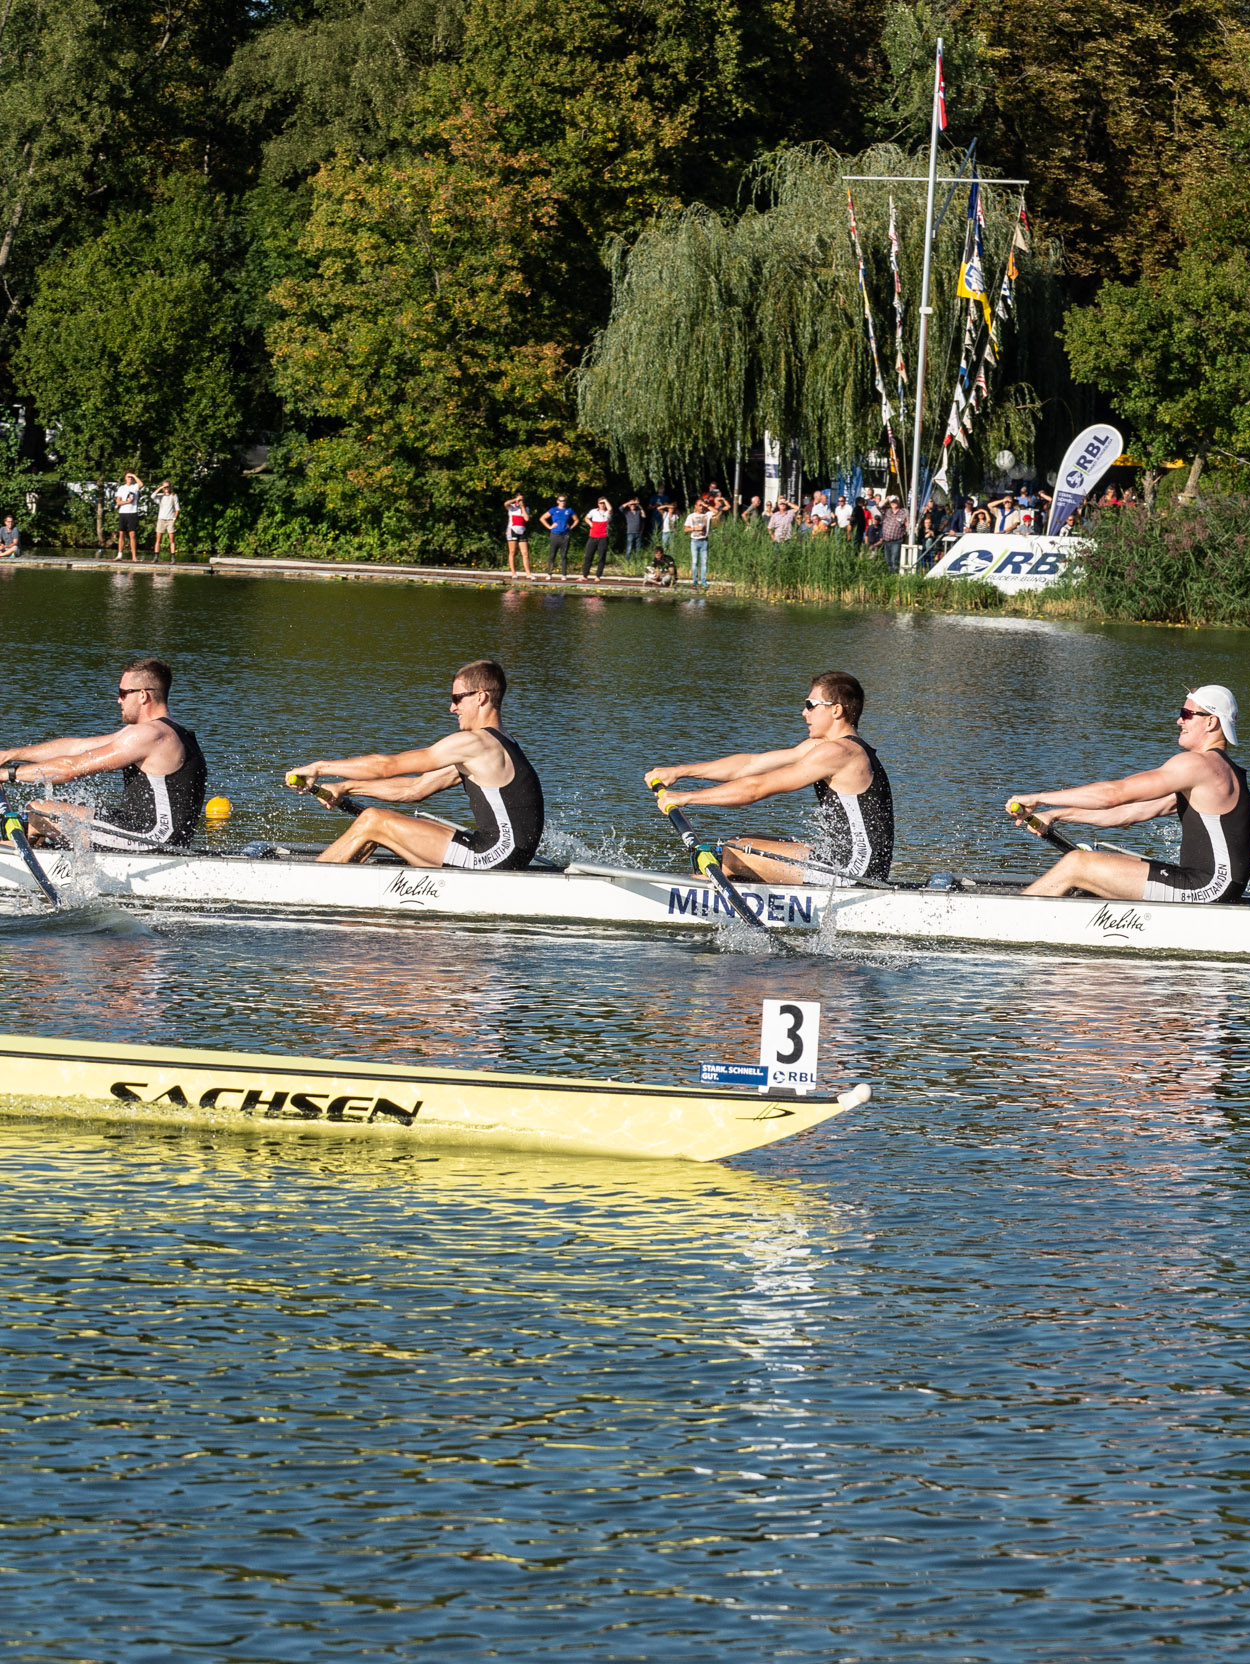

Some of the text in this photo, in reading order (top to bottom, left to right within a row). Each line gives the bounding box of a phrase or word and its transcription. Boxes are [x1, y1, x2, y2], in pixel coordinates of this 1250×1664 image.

[1076, 435, 1110, 471] RBL
[383, 870, 440, 898] Melitta
[668, 887, 812, 924] MINDEN
[1086, 903, 1146, 931] Melitta
[776, 1004, 804, 1064] 3
[702, 1065, 764, 1076] STARK. SCHNELL.
[788, 1071, 816, 1083] RBL
[110, 1081, 424, 1126] SACHSEN
